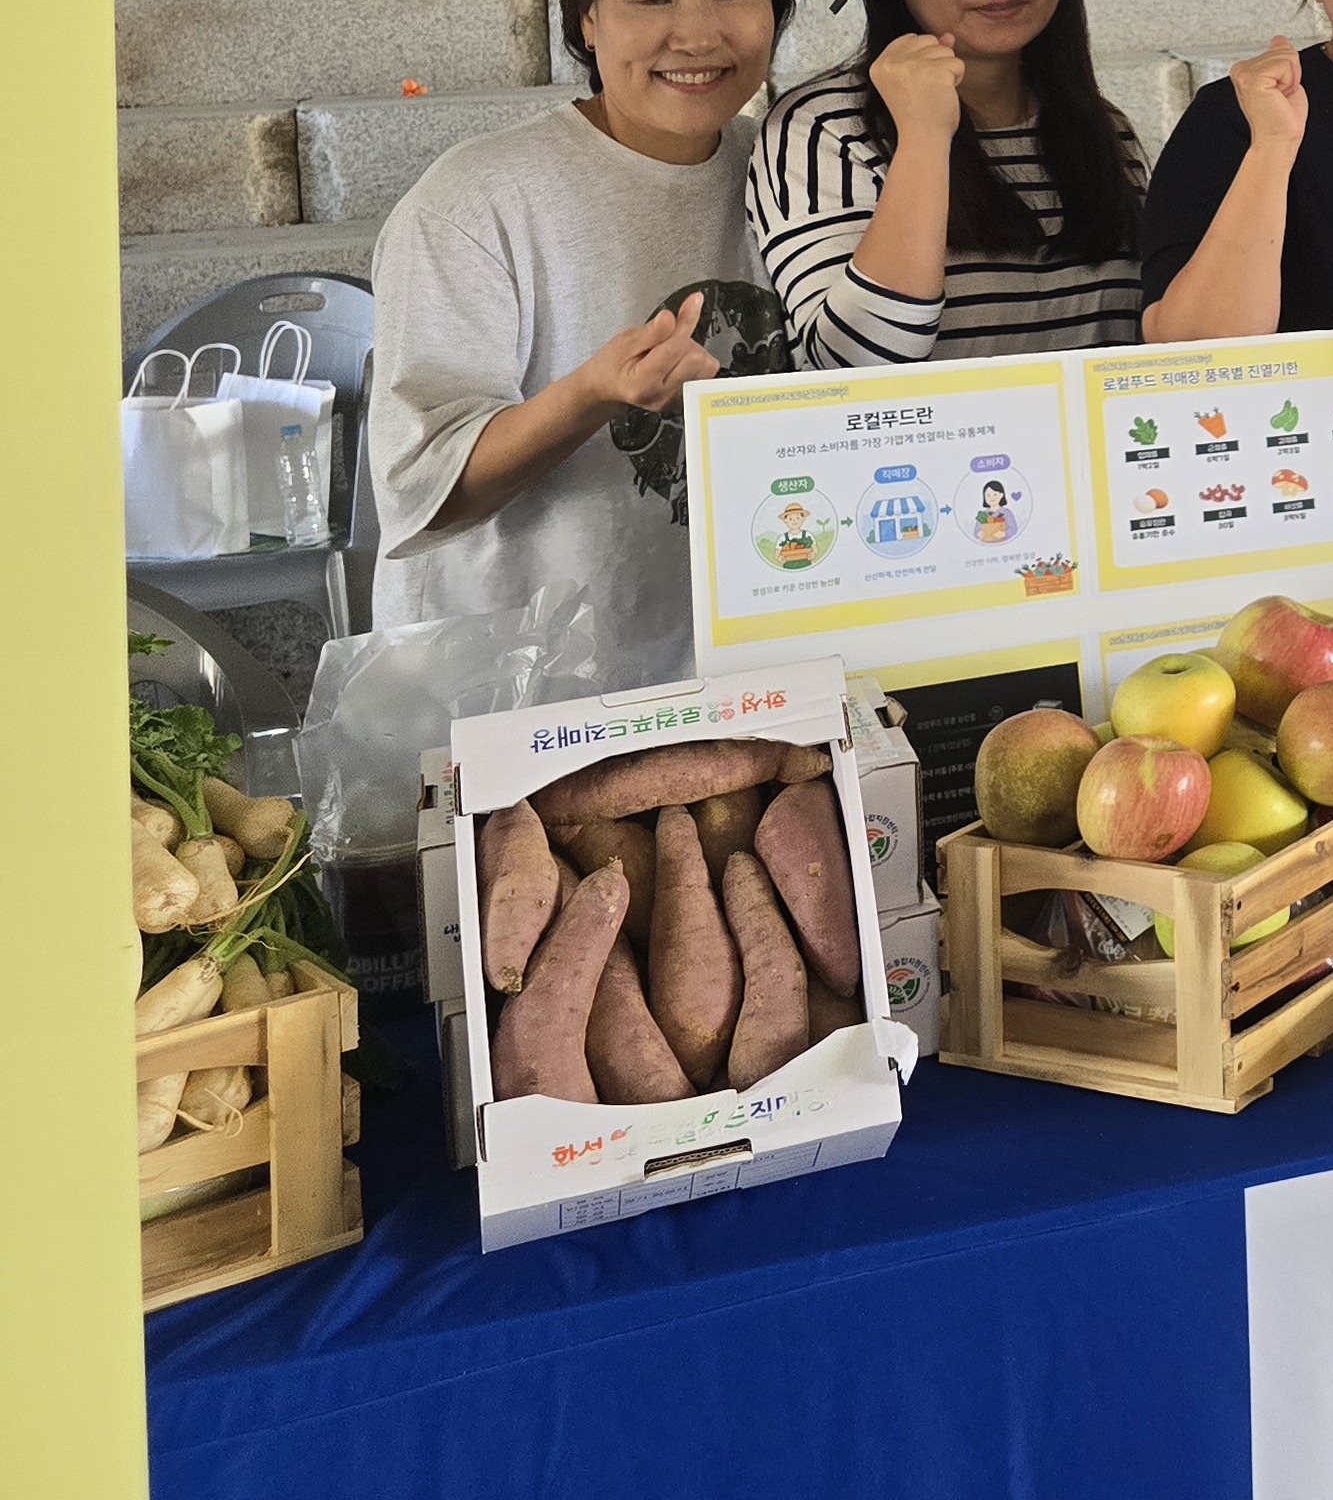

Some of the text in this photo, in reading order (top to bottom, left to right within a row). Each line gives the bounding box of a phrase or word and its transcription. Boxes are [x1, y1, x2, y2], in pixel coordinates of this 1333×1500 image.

[1103, 361, 1299, 392] 로컬푸드 직매장 품목별 진열기한
[845, 406, 934, 432] 로컬푸드란
[776, 444, 816, 459] 생산자와
[819, 438, 859, 454] 소비자를
[862, 436, 882, 450] 가장
[884, 432, 915, 448] 가깝게
[917, 429, 955, 445] 연결하는
[882, 467, 911, 480] 직매장
[976, 456, 1005, 470] 소비자
[777, 479, 809, 493] 생산자
[530, 690, 787, 753] 화성 로컬푸드직매장
